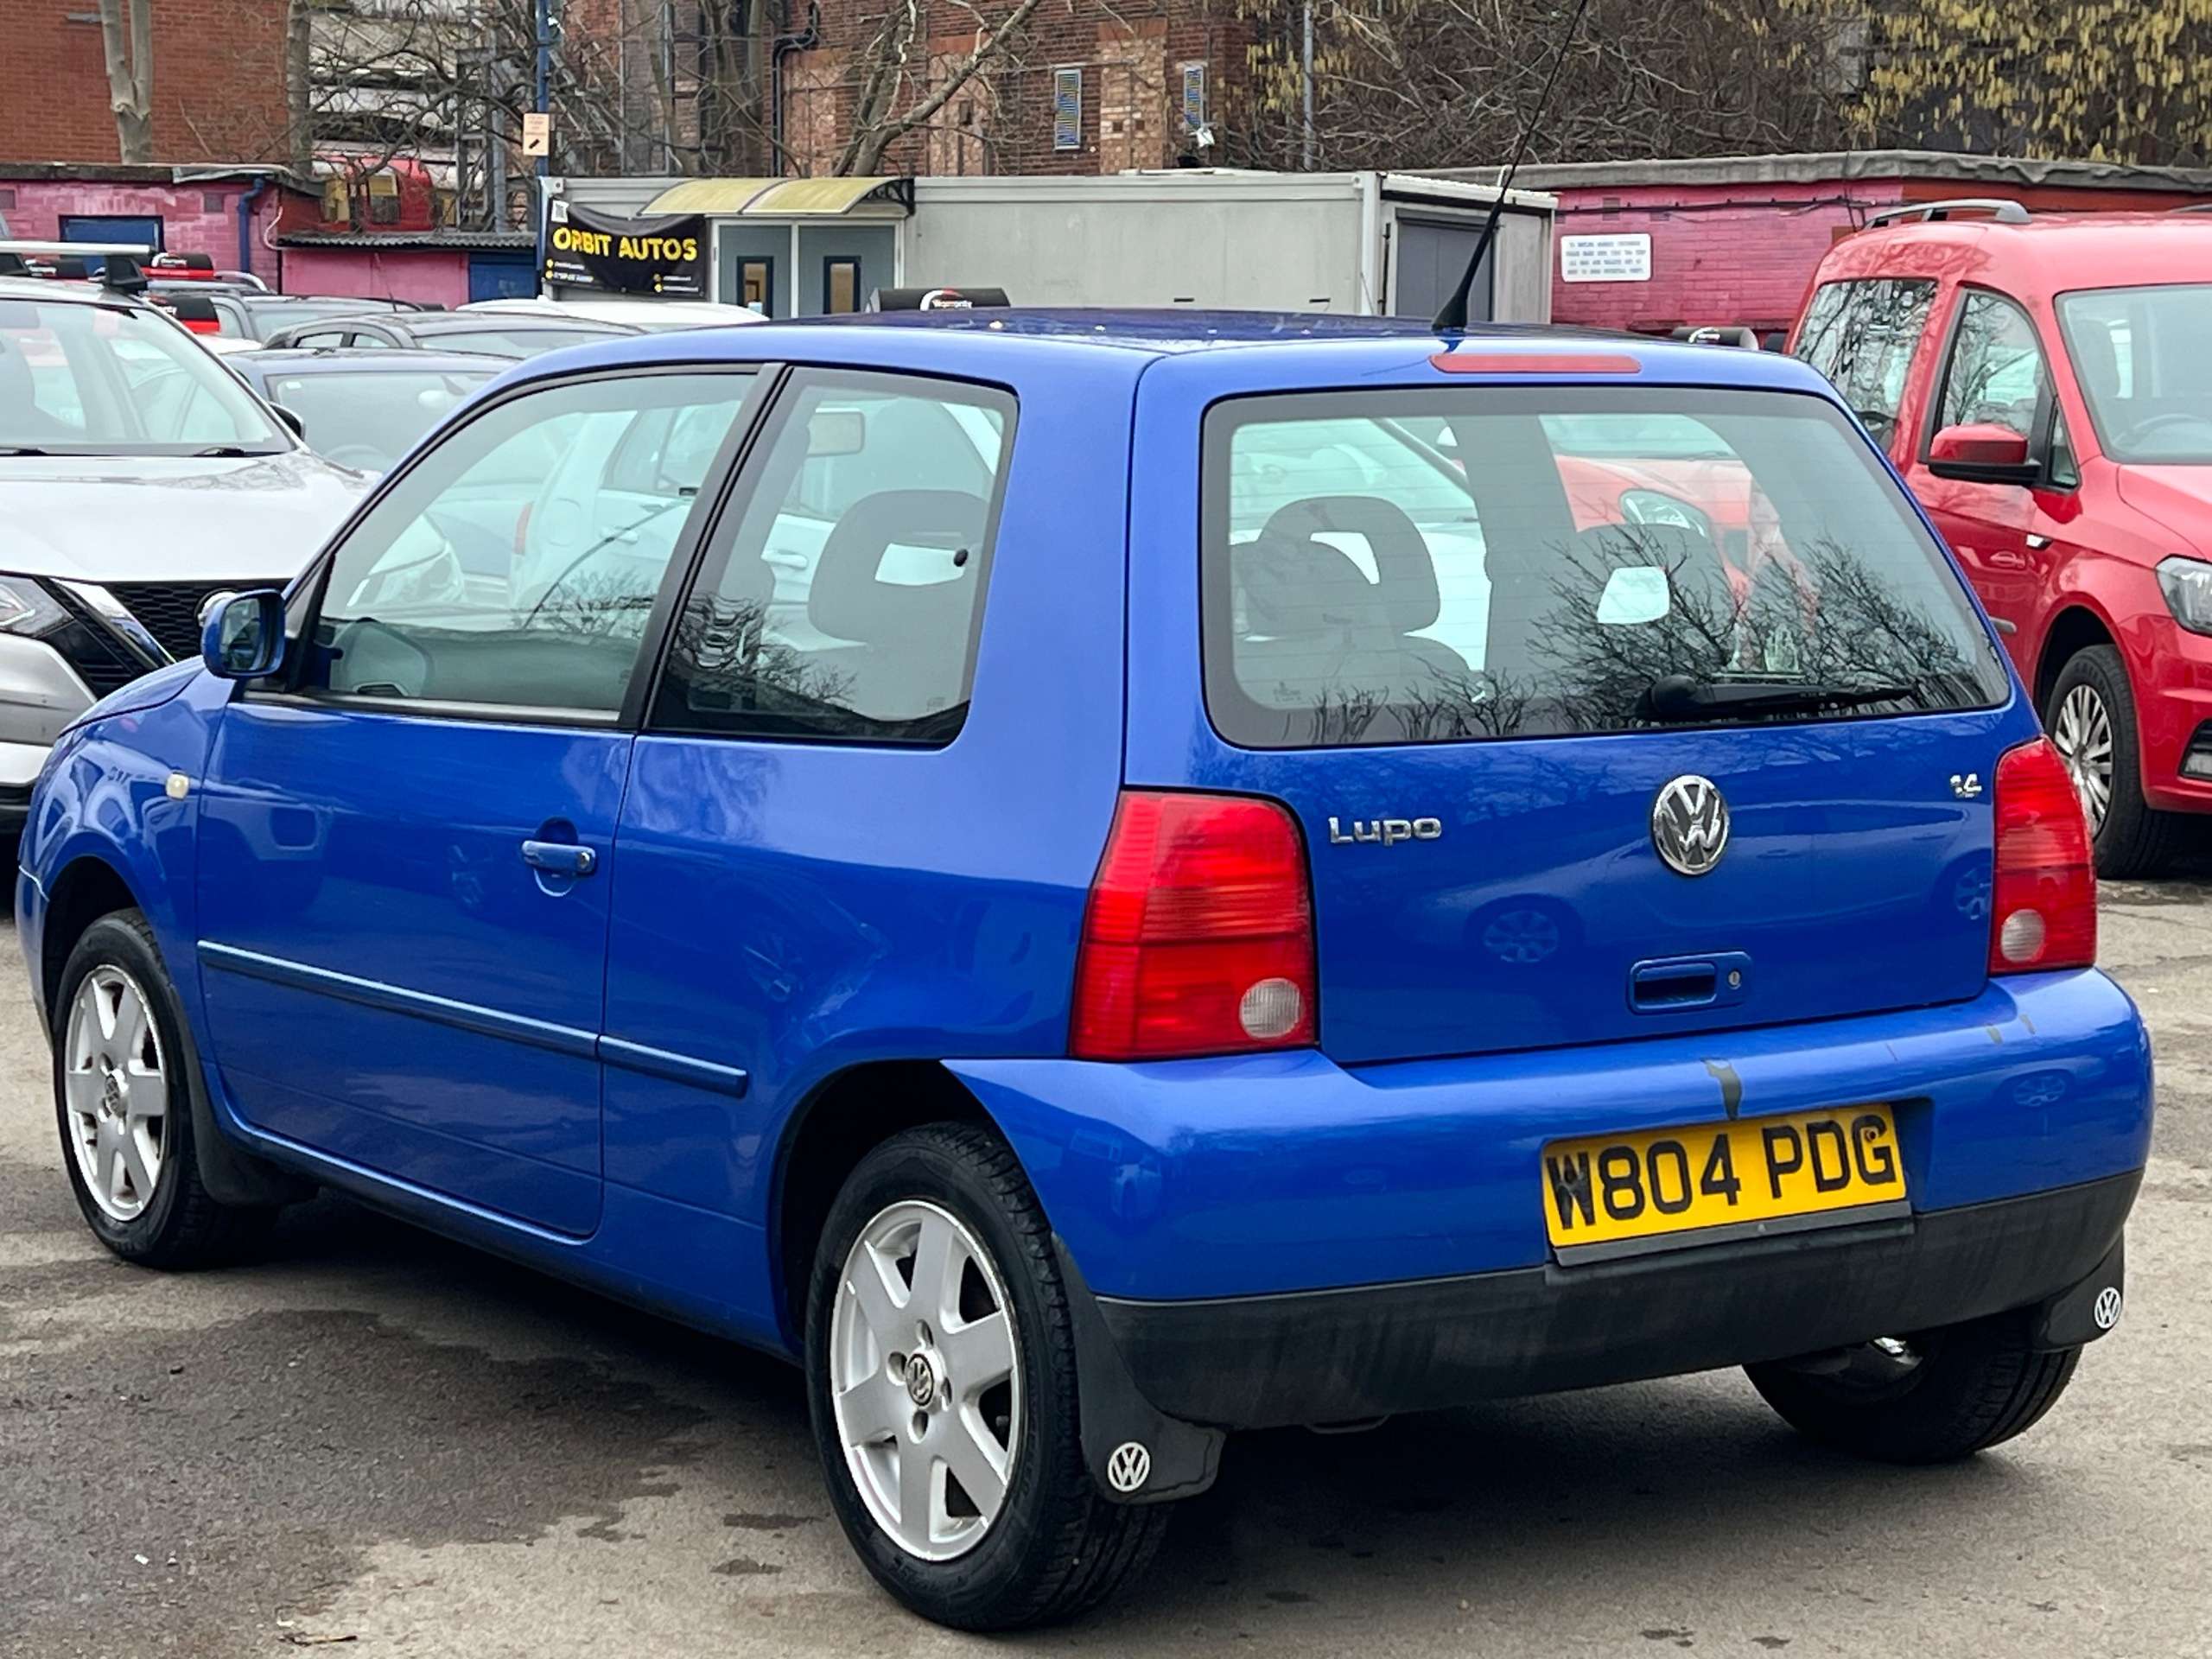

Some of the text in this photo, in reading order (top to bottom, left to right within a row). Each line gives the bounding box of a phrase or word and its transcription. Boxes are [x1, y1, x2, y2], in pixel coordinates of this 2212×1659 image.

[553, 227, 698, 261] ORBIT AUTOS
[1328, 817, 1442, 847] Lupo
[1654, 776, 1729, 874] VW
[1546, 1115, 1897, 1230] W804 PDG
